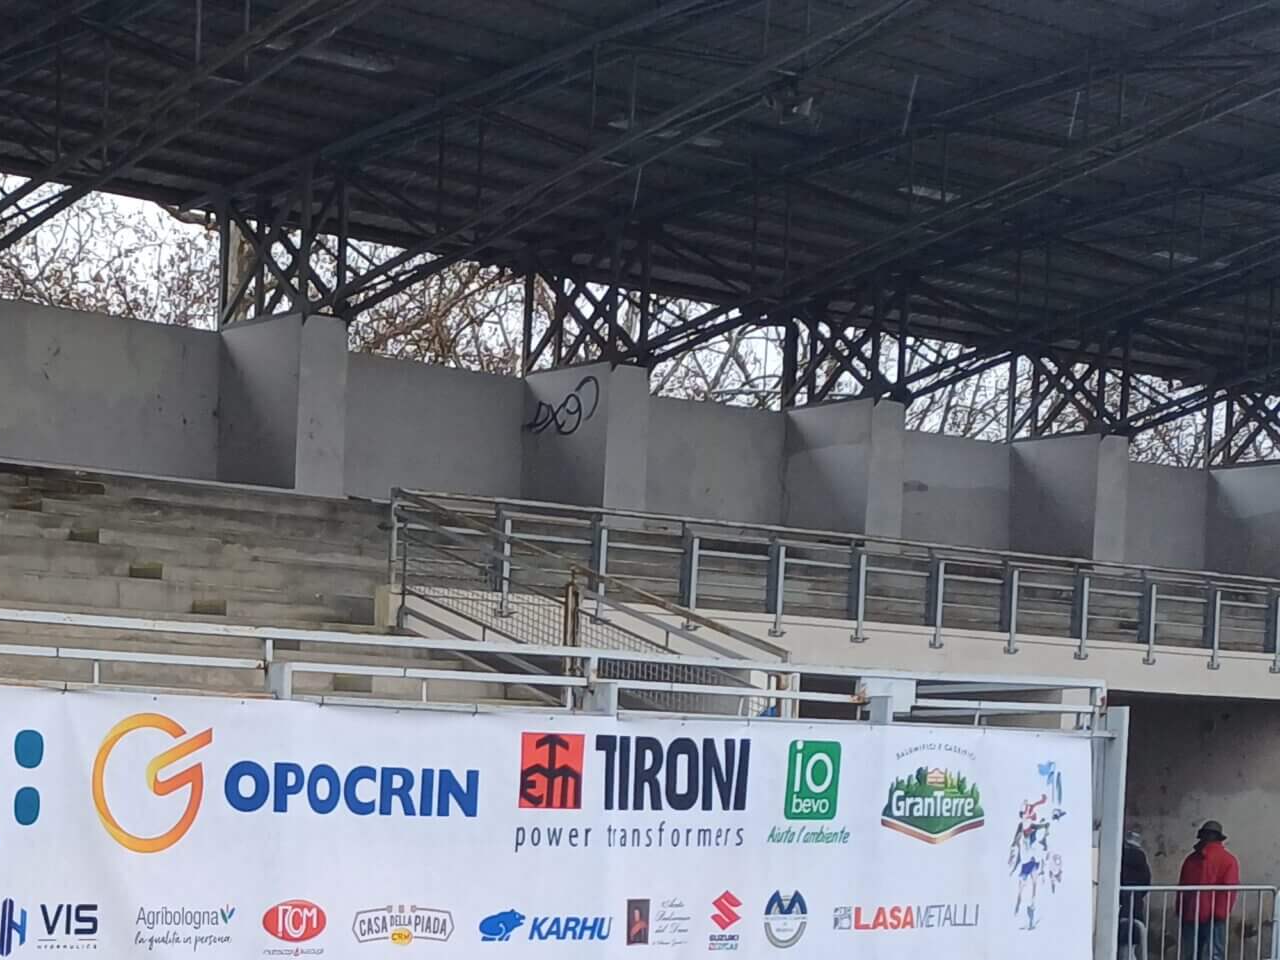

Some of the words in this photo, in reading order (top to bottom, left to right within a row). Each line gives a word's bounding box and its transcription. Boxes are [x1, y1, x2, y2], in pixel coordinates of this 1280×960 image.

[595, 734, 751, 811] TIRONI
[793, 740, 834, 793] io
[223, 760, 480, 818] OPOCRIN
[791, 795, 830, 814] bevo
[891, 789, 974, 817] GranTerre
[514, 825, 592, 853] power
[607, 821, 744, 848] transformers
[767, 826, 794, 844] Aiuta
[39, 904, 99, 935] VIS
[135, 906, 219, 931] Agribologna
[359, 915, 388, 937] CASA
[389, 914, 412, 927] DELLA
[414, 914, 448, 937] PIADA
[528, 916, 613, 941] KARHU
[134, 931, 147, 945] la
